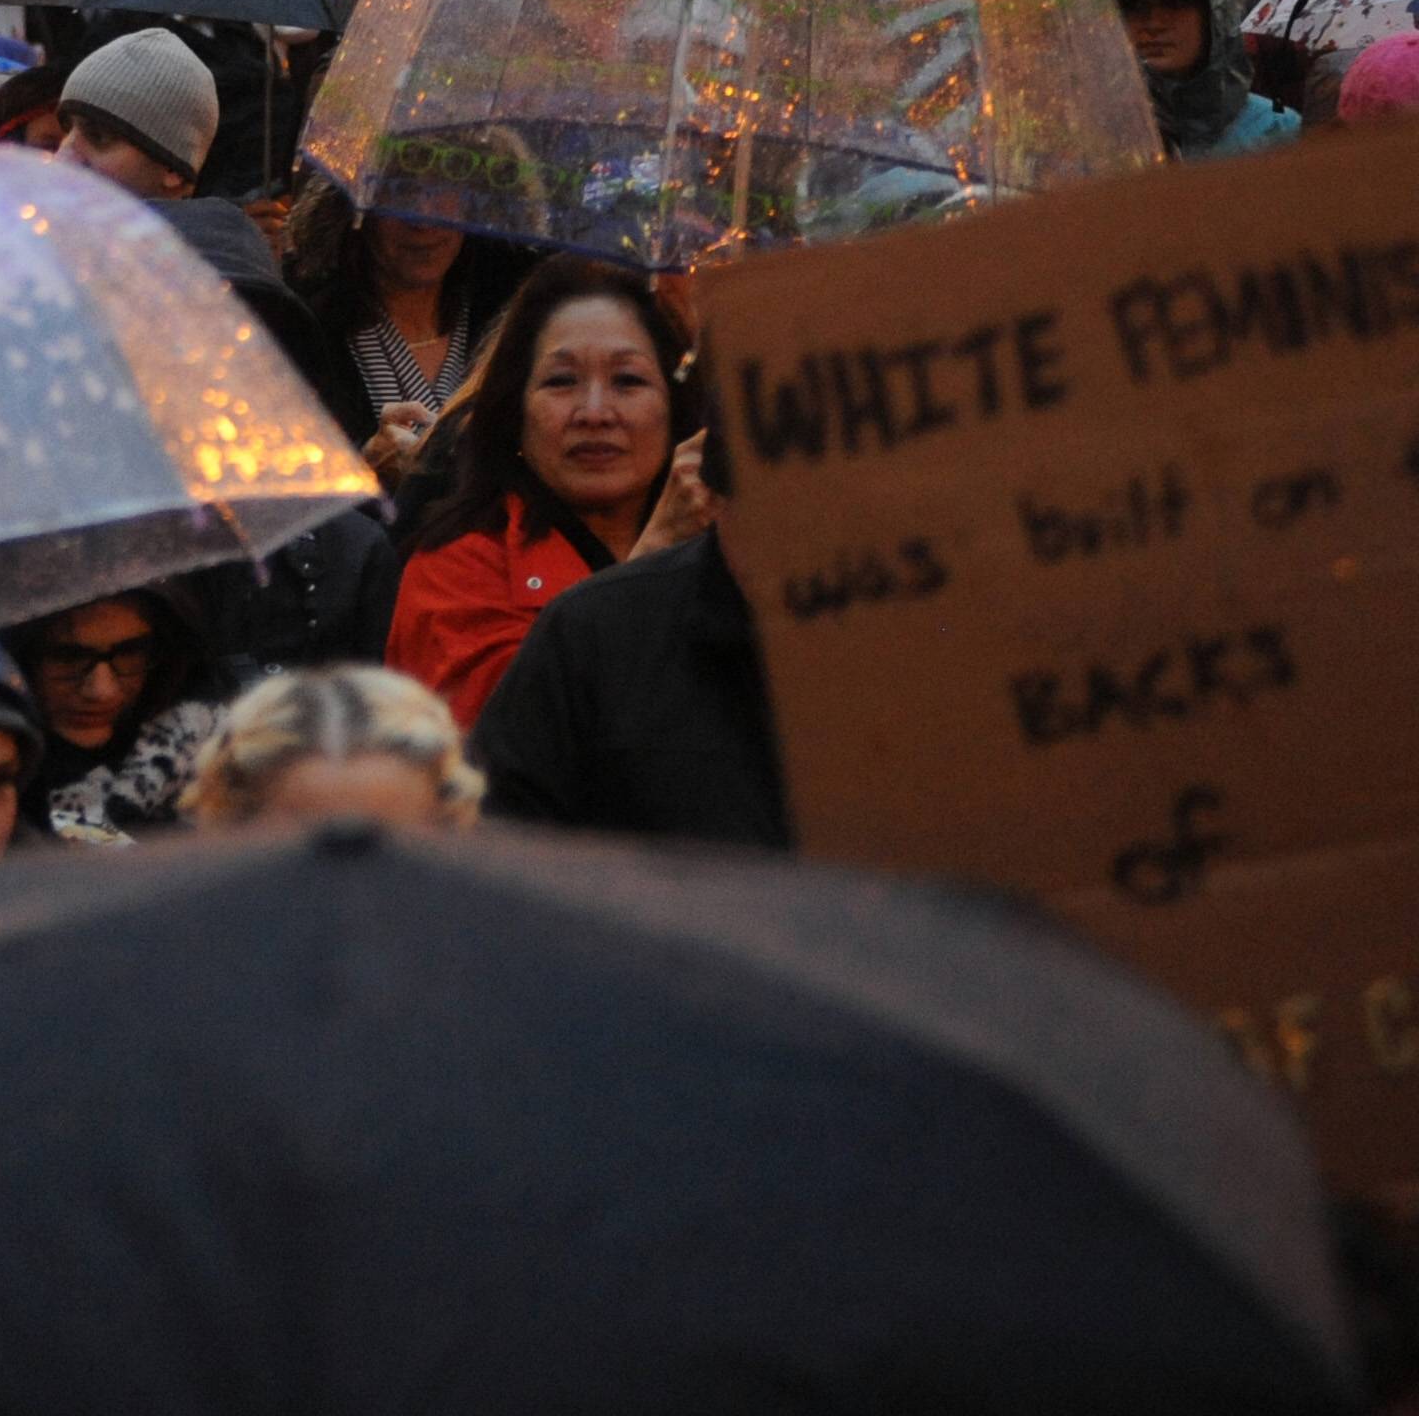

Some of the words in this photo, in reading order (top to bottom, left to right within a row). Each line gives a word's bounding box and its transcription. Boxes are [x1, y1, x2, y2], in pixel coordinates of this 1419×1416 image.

[735, 309, 1068, 468] WHITE
[1019, 468, 1187, 566] built
[1251, 466, 1344, 532] on
[1007, 624, 1299, 747] BACKS
[1110, 787, 1231, 908] of
